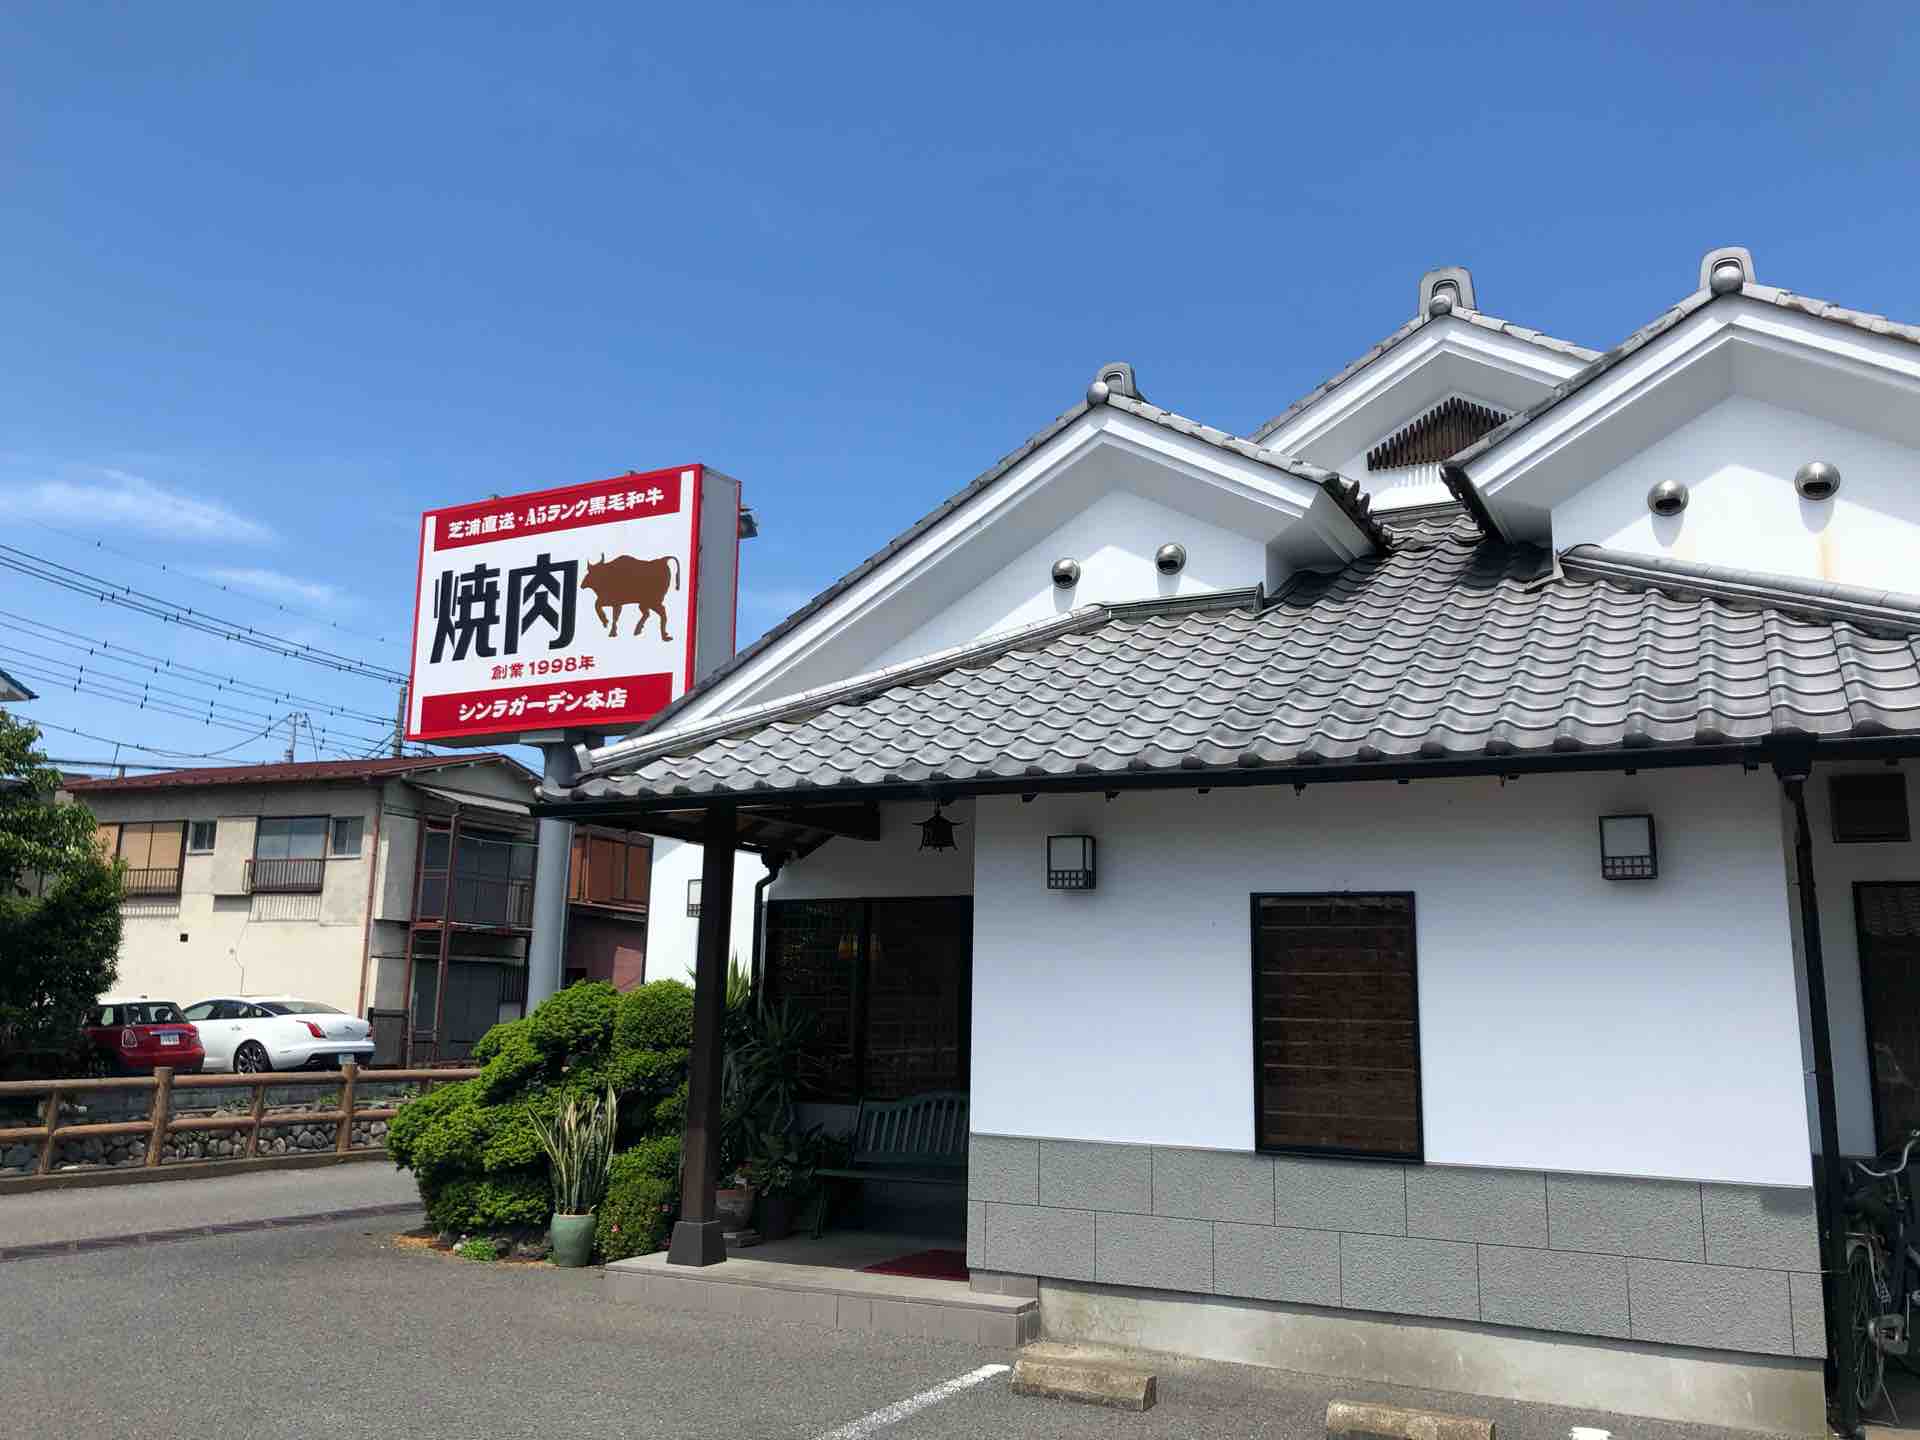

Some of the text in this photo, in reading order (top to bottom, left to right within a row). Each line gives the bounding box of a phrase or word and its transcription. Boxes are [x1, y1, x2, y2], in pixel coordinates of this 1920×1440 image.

[448, 487, 664, 539] 芝浦直送・A5ランク黒毛和牛
[429, 553, 579, 664] 焼肉
[459, 688, 628, 721] シンラガーデン本店
